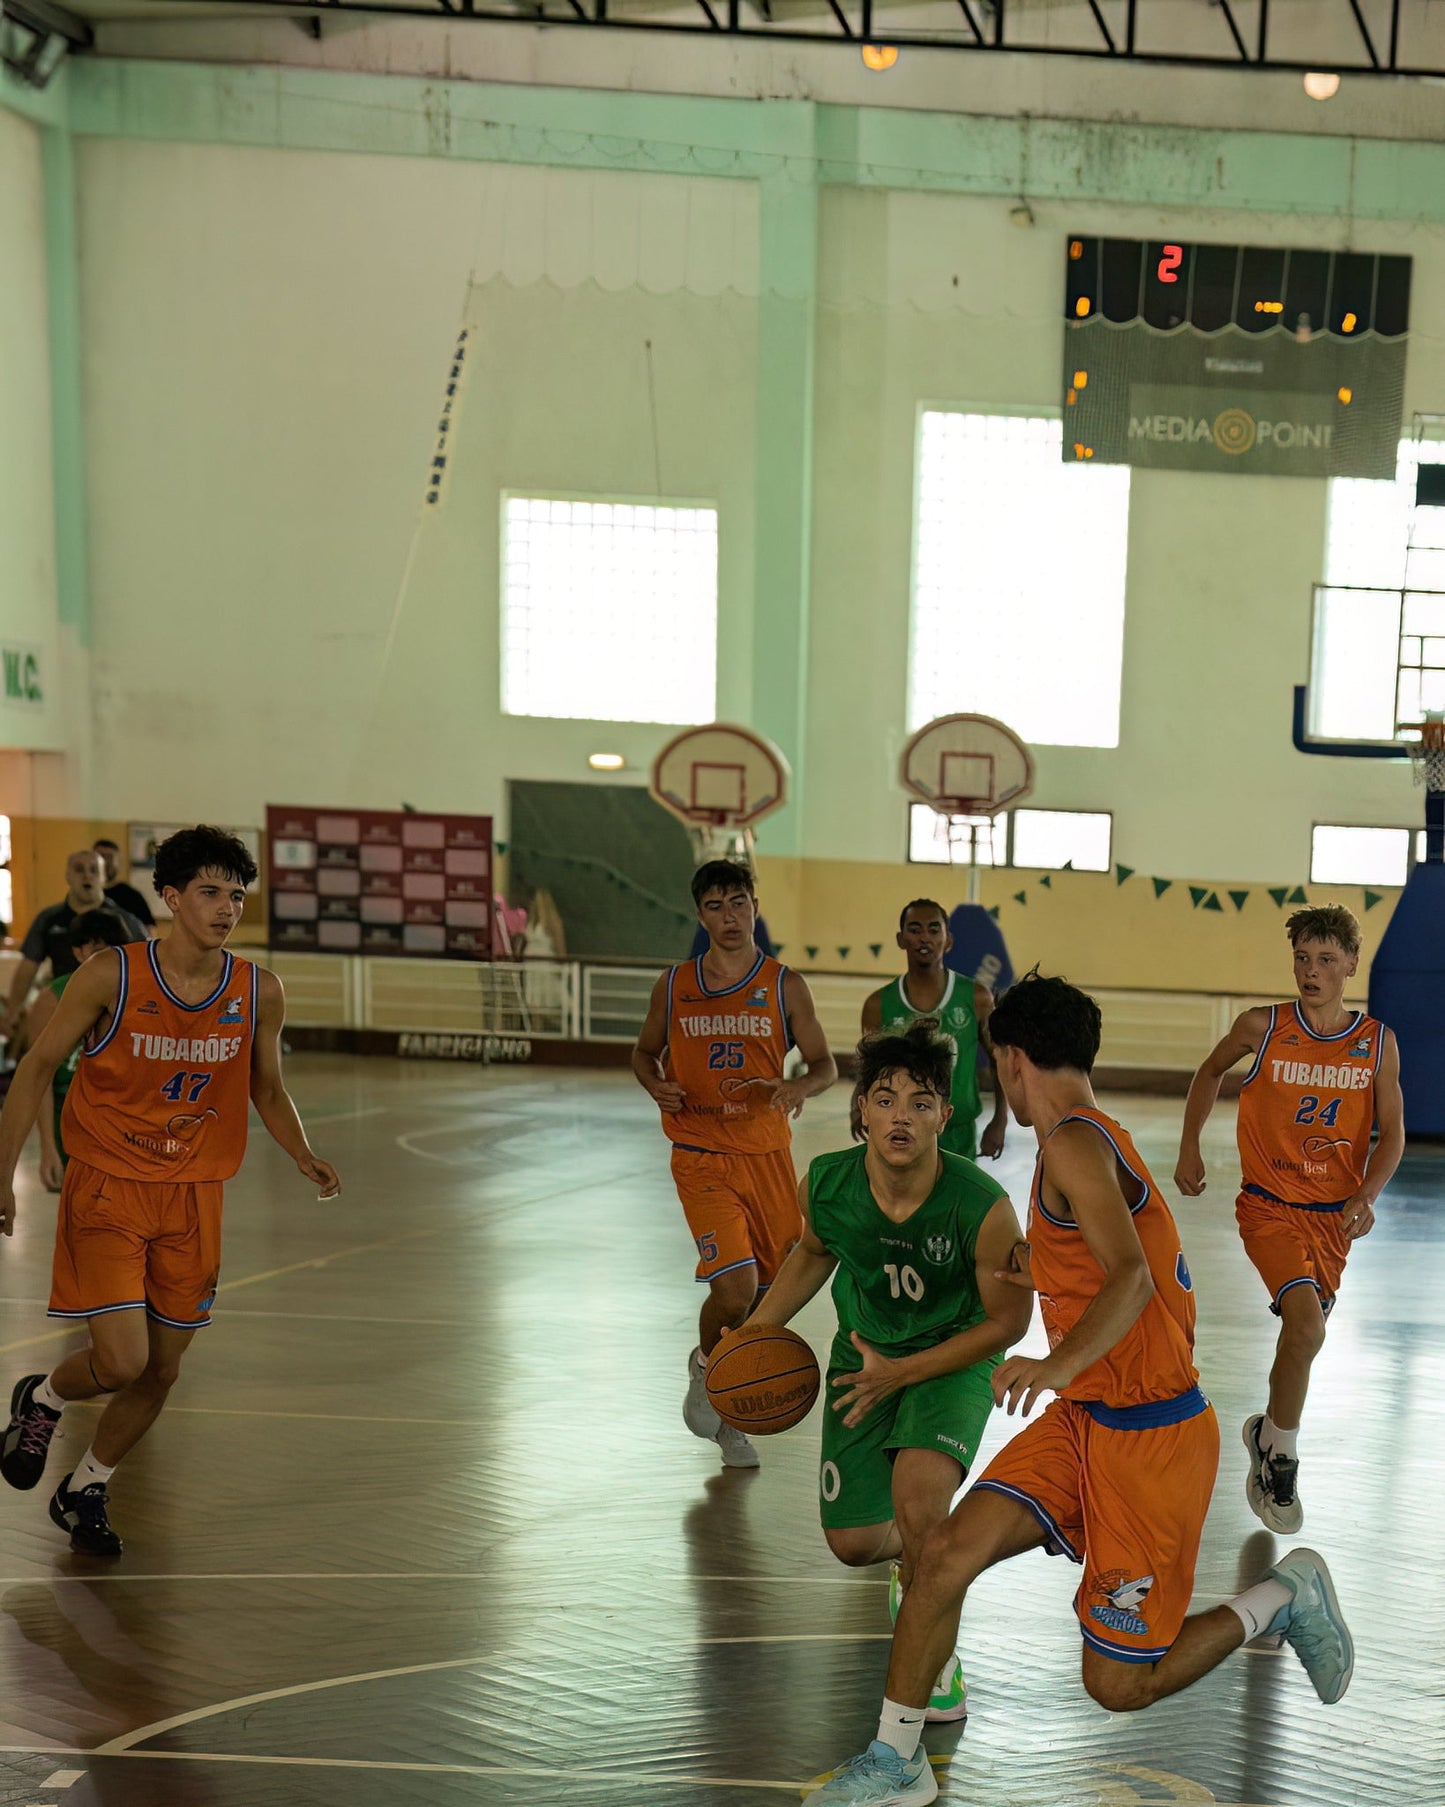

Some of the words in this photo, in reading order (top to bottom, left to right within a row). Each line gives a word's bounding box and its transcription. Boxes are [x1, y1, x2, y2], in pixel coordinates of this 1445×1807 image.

[1157, 244, 1183, 283] 2
[1127, 415, 1214, 443] MEDIA
[679, 1010, 773, 1038] TUBARÕES
[130, 1032, 242, 1063] TUBARÕES
[708, 1041, 745, 1071] 25
[160, 1070, 212, 1104] 47
[1271, 1059, 1373, 1091] TUBARÕES
[1294, 1095, 1342, 1127] 24
[883, 1263, 925, 1302] 10
